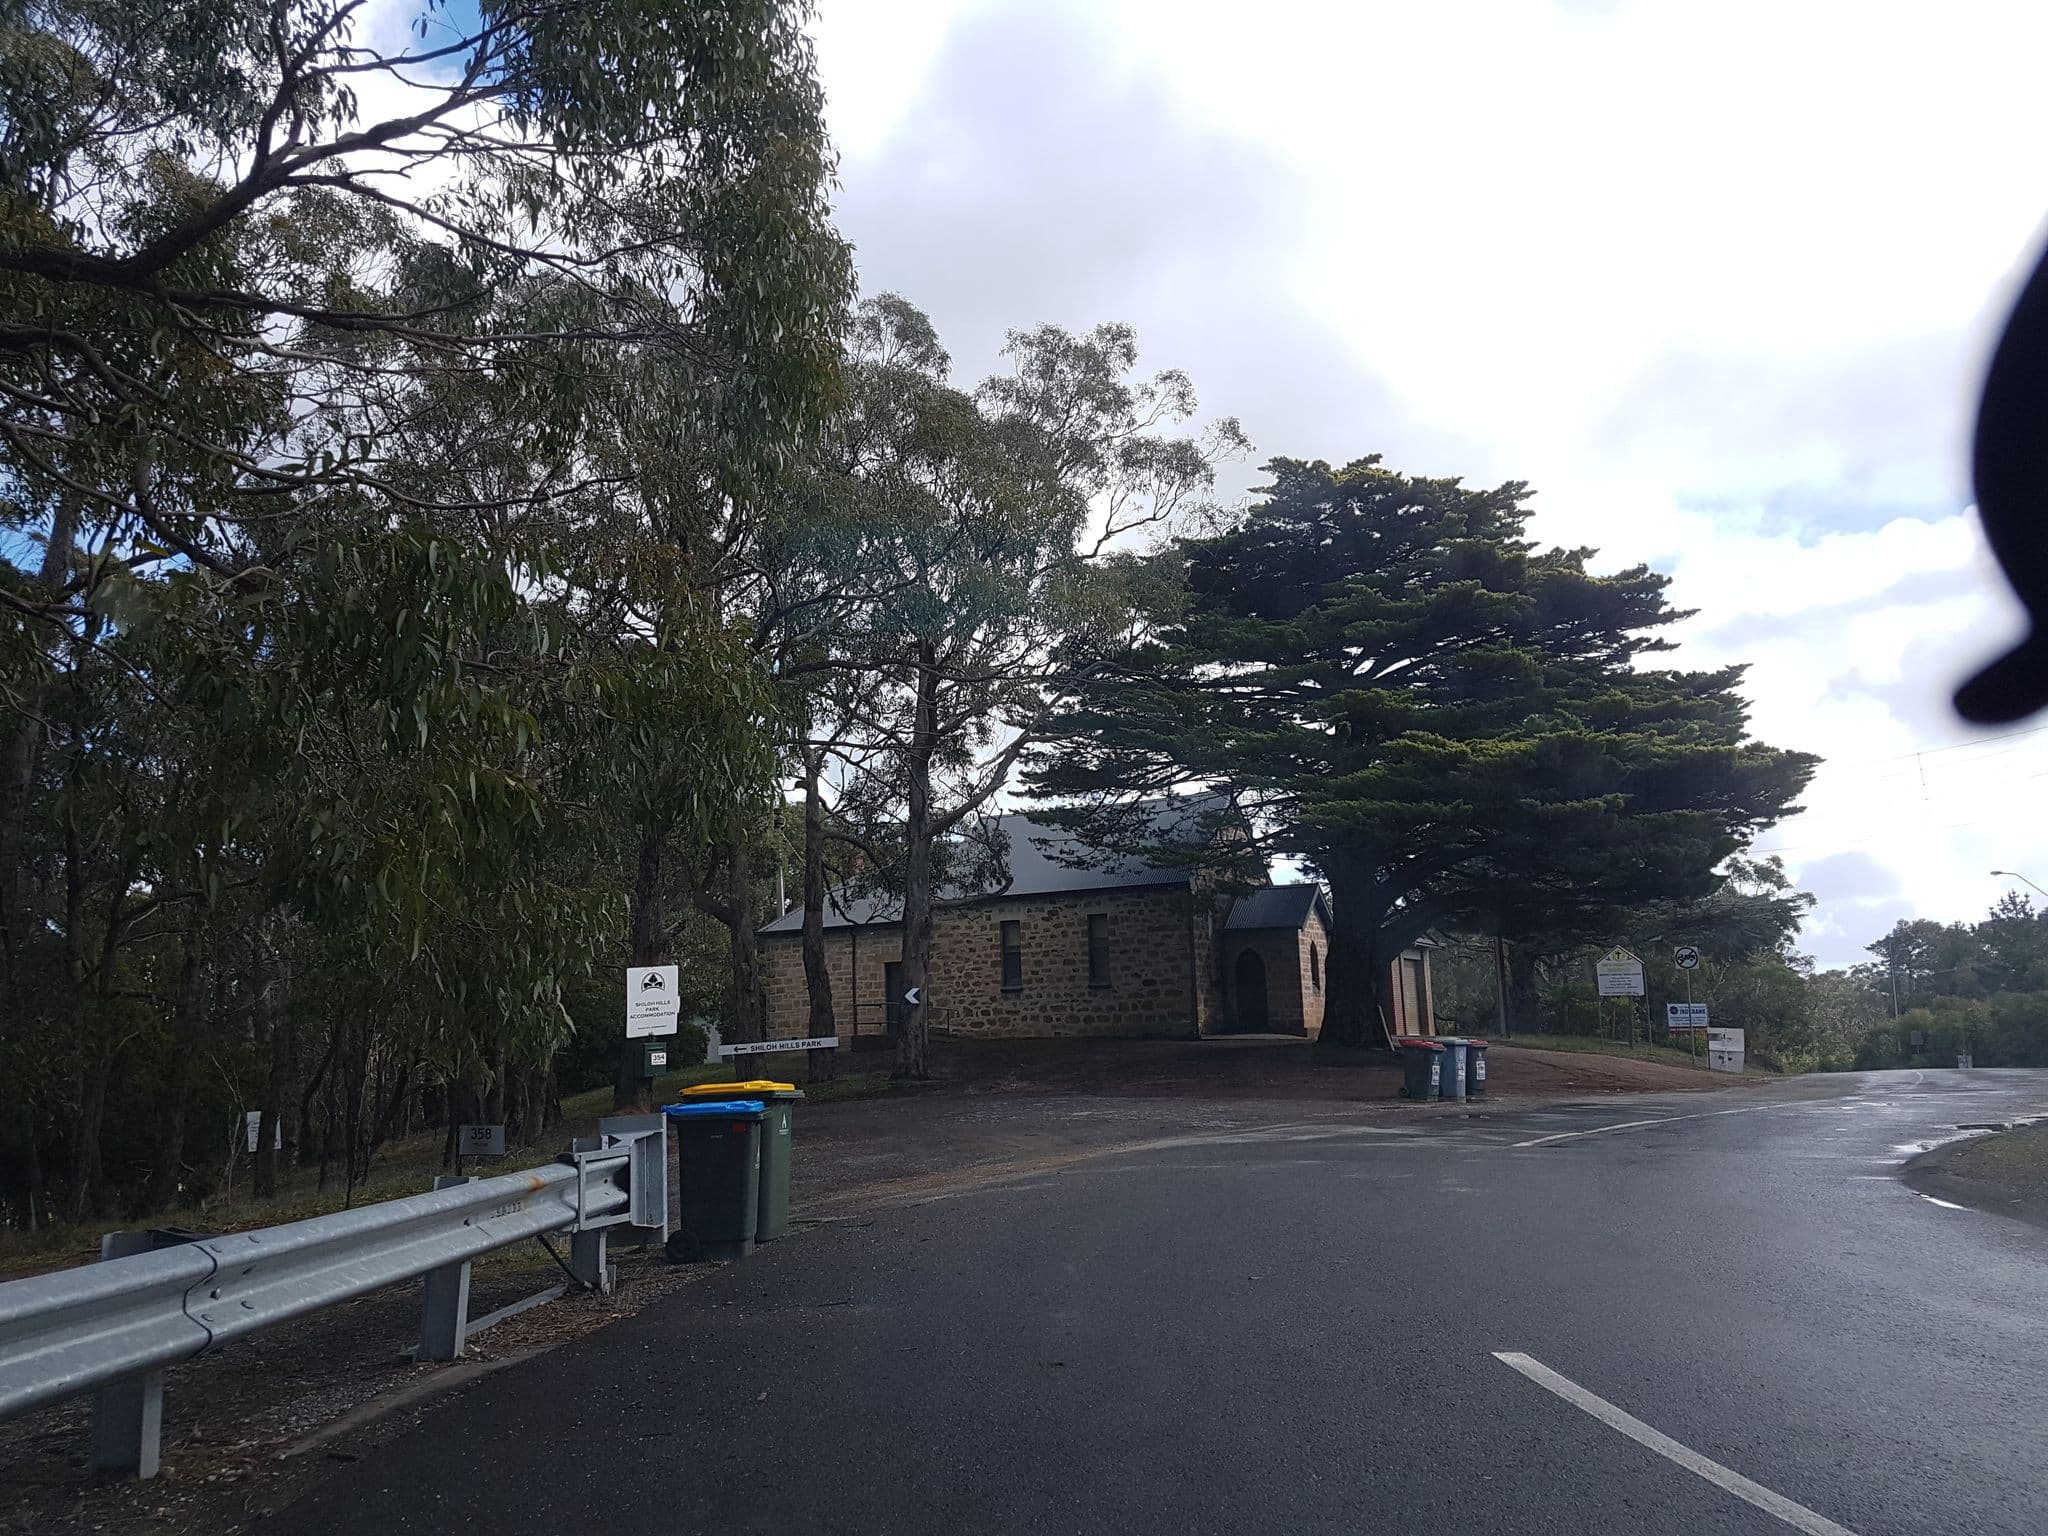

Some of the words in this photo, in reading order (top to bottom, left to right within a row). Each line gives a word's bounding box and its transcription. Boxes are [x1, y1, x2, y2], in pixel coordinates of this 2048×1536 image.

[750, 1044, 777, 1052] SHILOH
[780, 1042, 800, 1050] HILLS
[802, 1040, 822, 1048] PARK
[471, 1127, 492, 1140] 358
